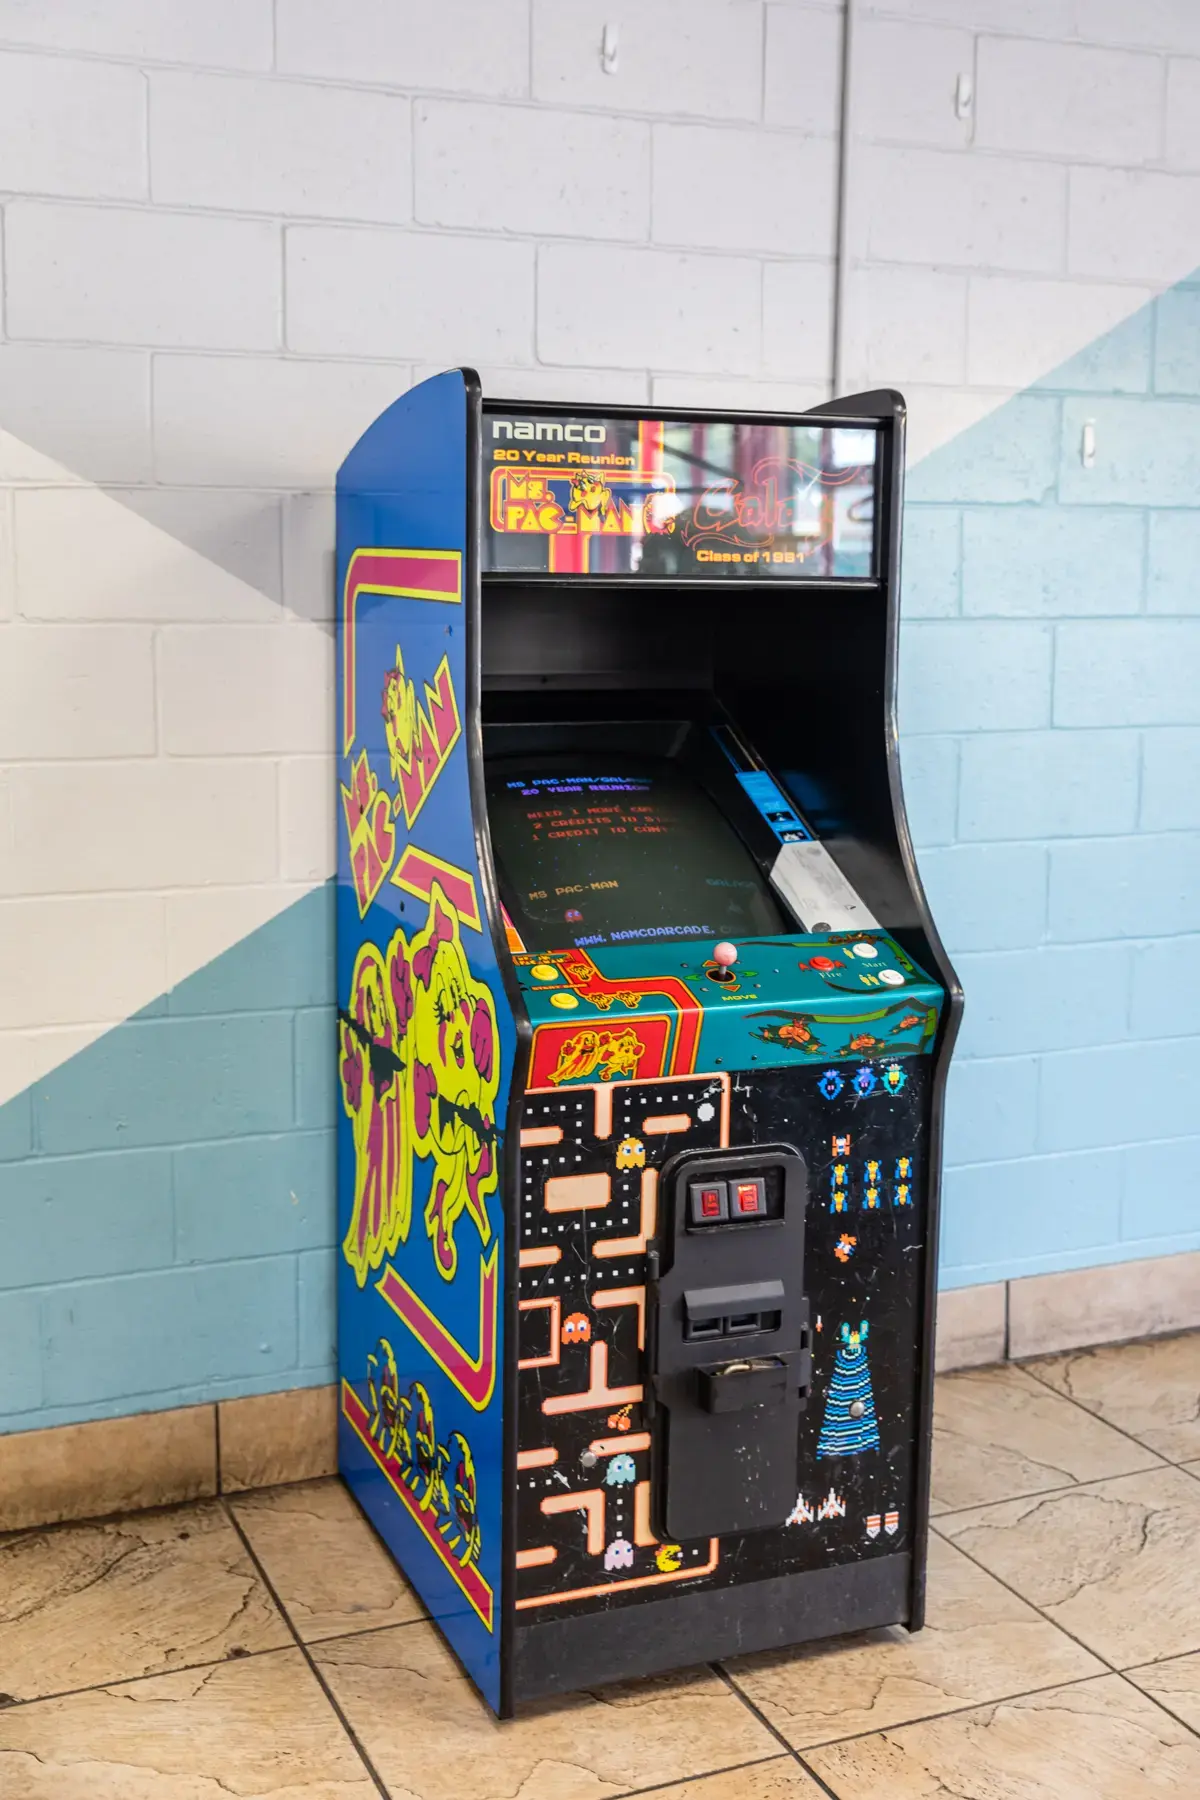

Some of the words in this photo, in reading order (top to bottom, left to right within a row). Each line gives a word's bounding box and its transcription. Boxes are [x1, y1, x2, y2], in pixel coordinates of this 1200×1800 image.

[492, 420, 607, 443] namco
[493, 449, 520, 461] 20
[522, 450, 566, 463] Year
[567, 452, 636, 466] Reunion
[504, 498, 644, 535] PAC-MAN
[696, 549, 742, 563] Class
[743, 551, 759, 563] of
[762, 551, 805, 564] 1981
[520, 788, 540, 796] 20
[547, 785, 584, 793] YEAR
[550, 816, 612, 827] CREDITS
[620, 815, 638, 824] TO
[547, 827, 599, 839] CREDIT
[609, 826, 627, 834] TO
[528, 890, 549, 901] MS
[554, 880, 620, 896] PAC-MAN
[574, 934, 607, 947] WWW.
[610, 924, 716, 941] NAMCOARCADE.
[818, 971, 843, 979] Fire
[721, 993, 758, 1001] MOVE
